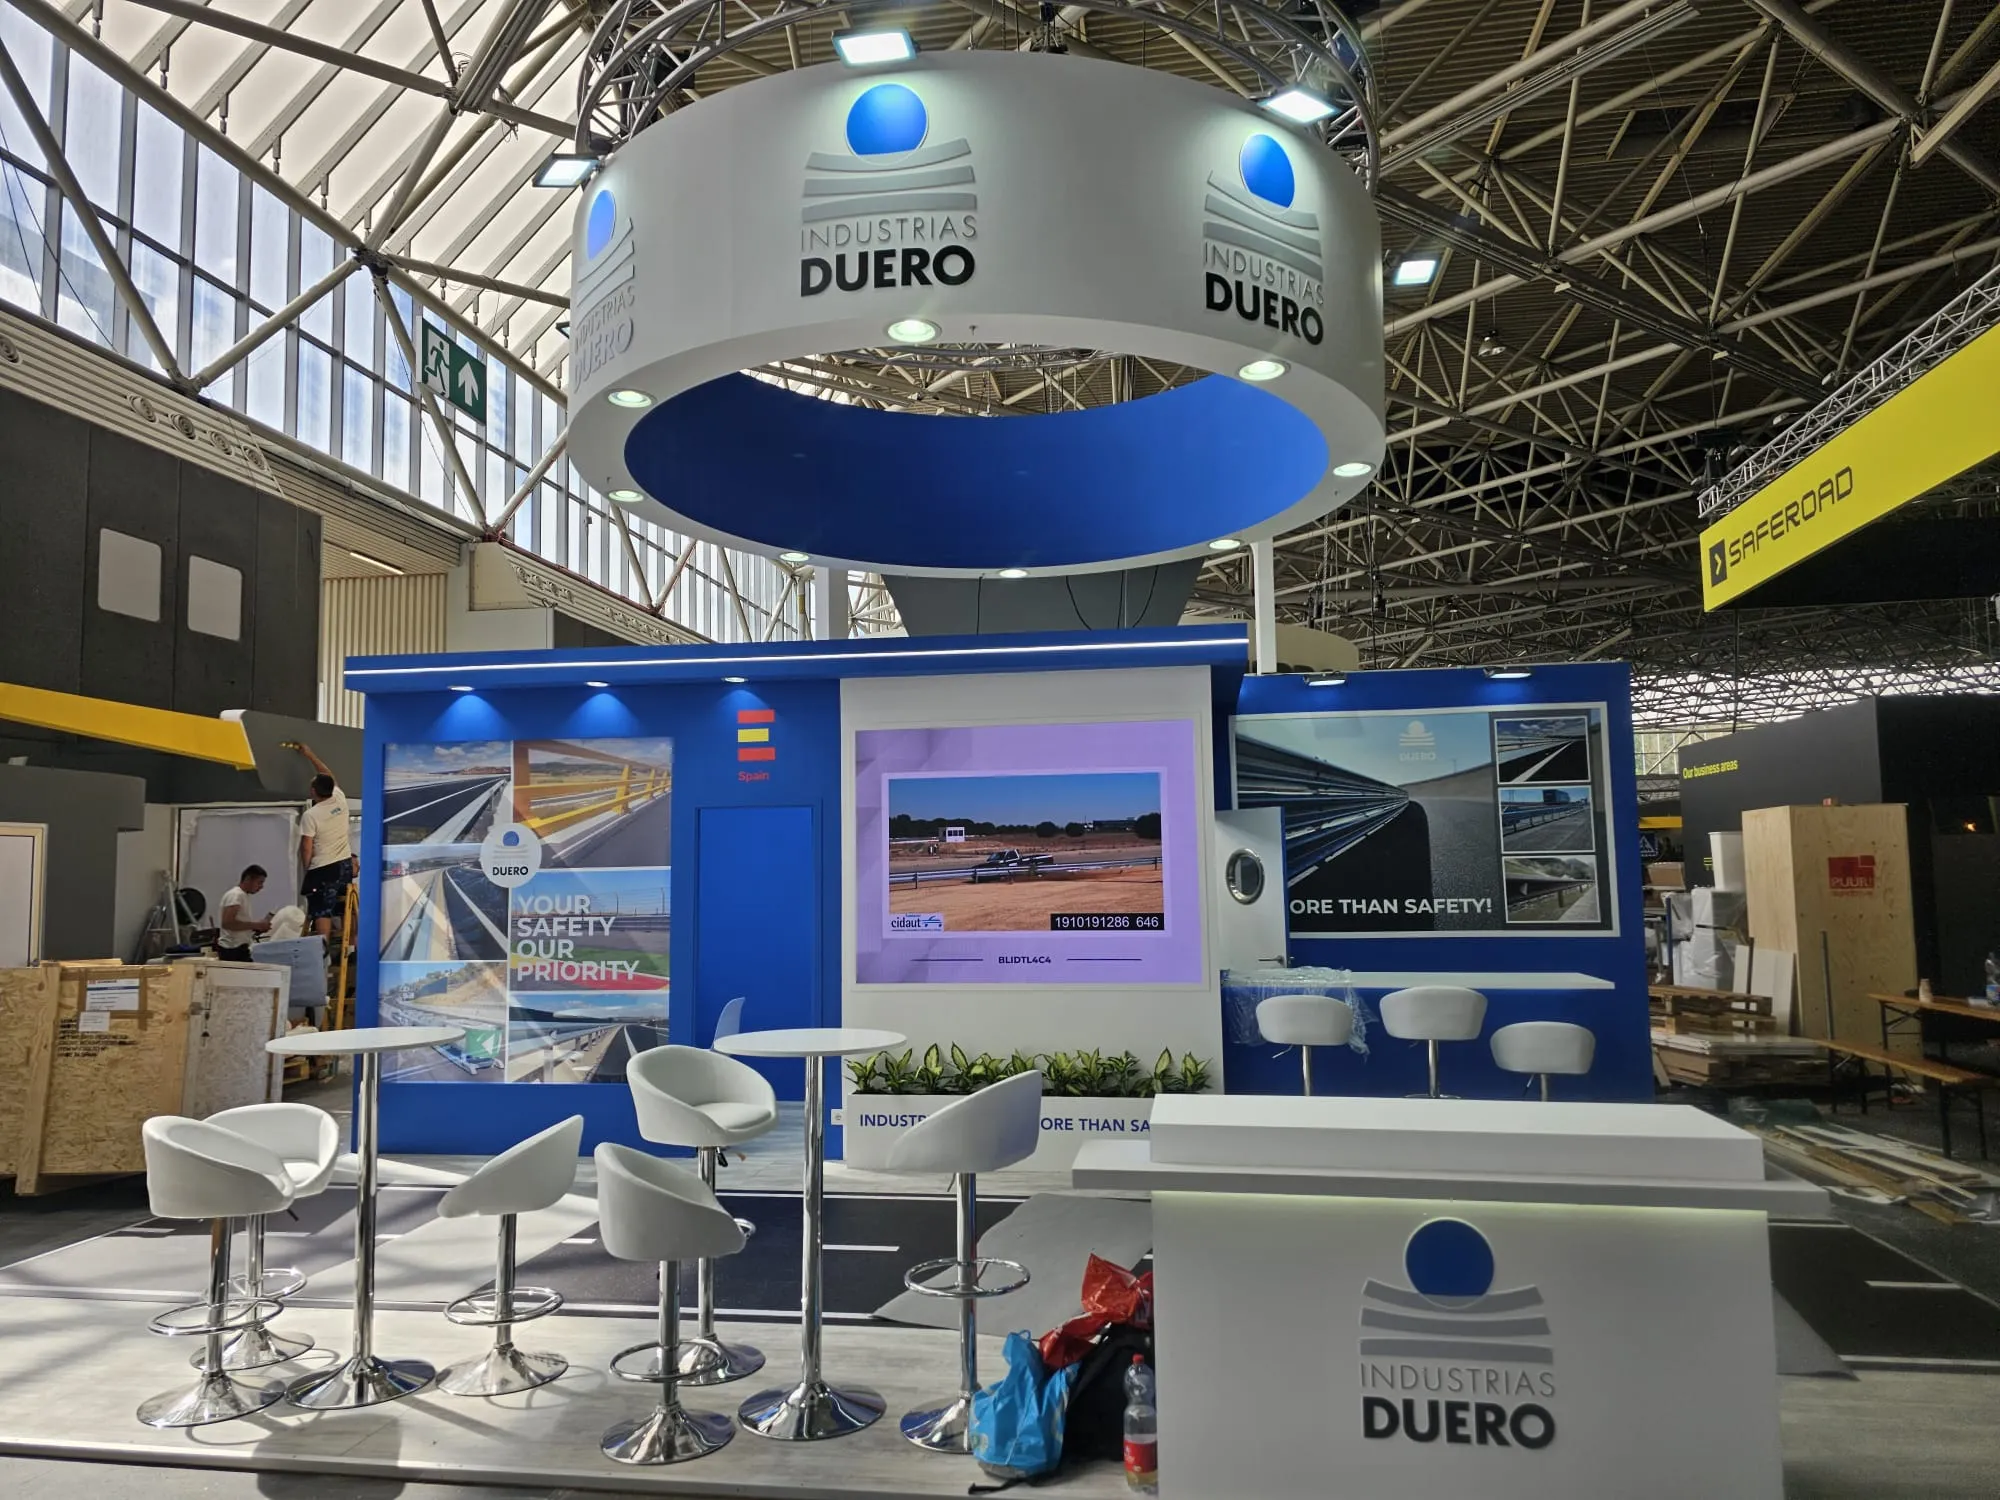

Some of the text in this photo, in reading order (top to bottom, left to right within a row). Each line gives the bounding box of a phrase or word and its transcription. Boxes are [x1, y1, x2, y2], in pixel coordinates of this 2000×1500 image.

[801, 215, 977, 251] INDUSTRIAS
[801, 245, 975, 297] DUERO
[1204, 241, 1324, 305] INDUSTRIAS
[1205, 271, 1324, 346] DUERO
[573, 316, 635, 395] DUERO
[1728, 465, 1853, 567] SAFEROAD
[738, 770, 770, 783] Spain
[1682, 760, 1739, 779] Our business areas
[492, 866, 529, 876] DUERO
[517, 894, 591, 915] YOUR
[1289, 898, 1492, 914] ORE THAN SAFETY!
[517, 916, 616, 937] SAFETY
[891, 916, 921, 928] cidaut
[1055, 916, 1159, 928] 1910191286 646
[516, 939, 574, 959] OUR
[517, 960, 640, 982] PRIORITY
[1040, 1117, 1151, 1132] ORE THAN SA
[1361, 1362, 1556, 1398] INDUSTRIAS
[1362, 1396, 1556, 1450] DUERO
